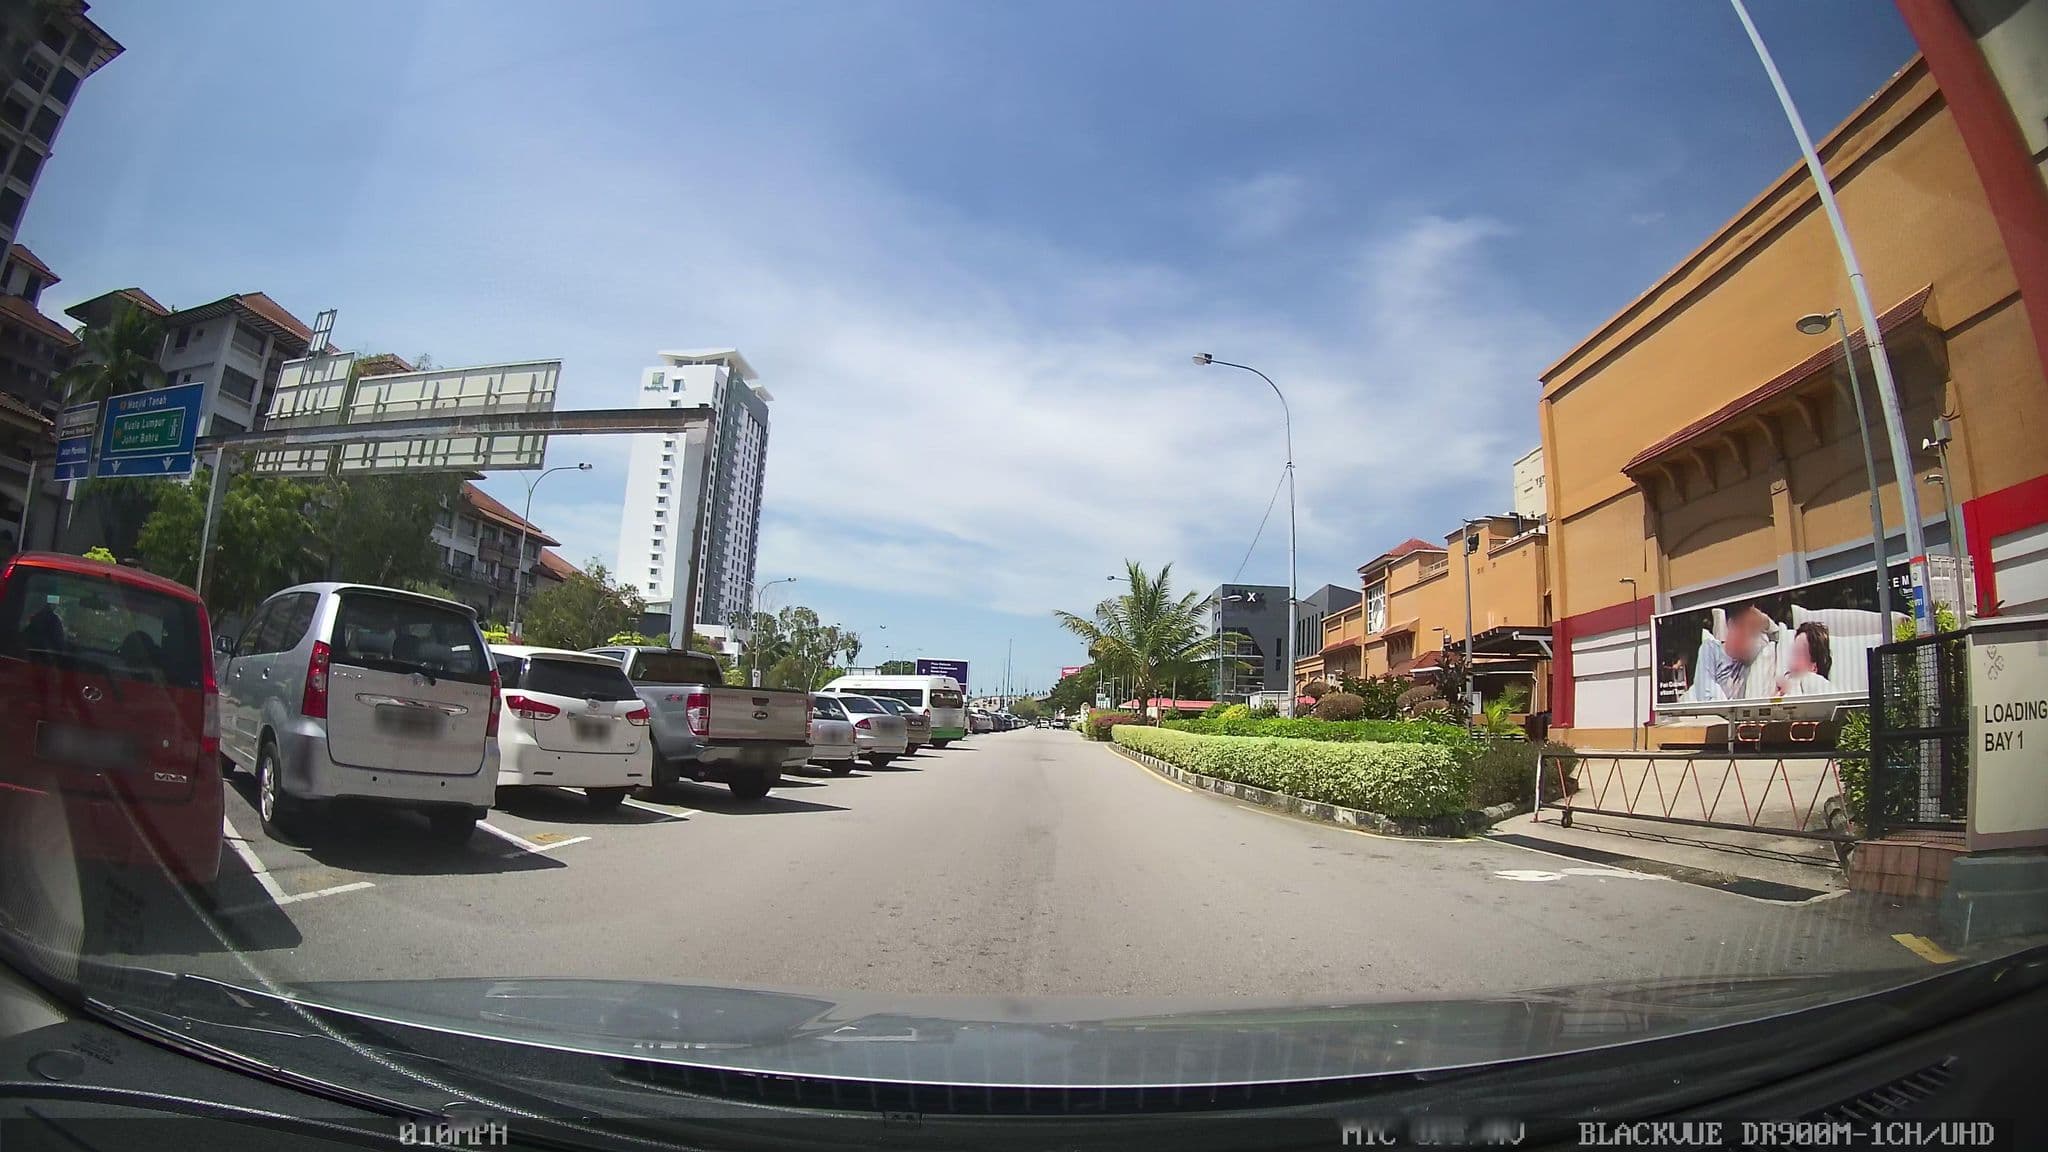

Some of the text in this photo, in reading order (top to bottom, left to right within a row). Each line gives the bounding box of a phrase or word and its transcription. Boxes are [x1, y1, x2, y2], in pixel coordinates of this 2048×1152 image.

[148, 395, 167, 408] Tanah
[124, 418, 166, 431] Kuala Lumpur
[1984, 701, 2047, 723] LOADING
[1984, 730, 2024, 752] BAY 1
[155, 773, 186, 783] VIVA
